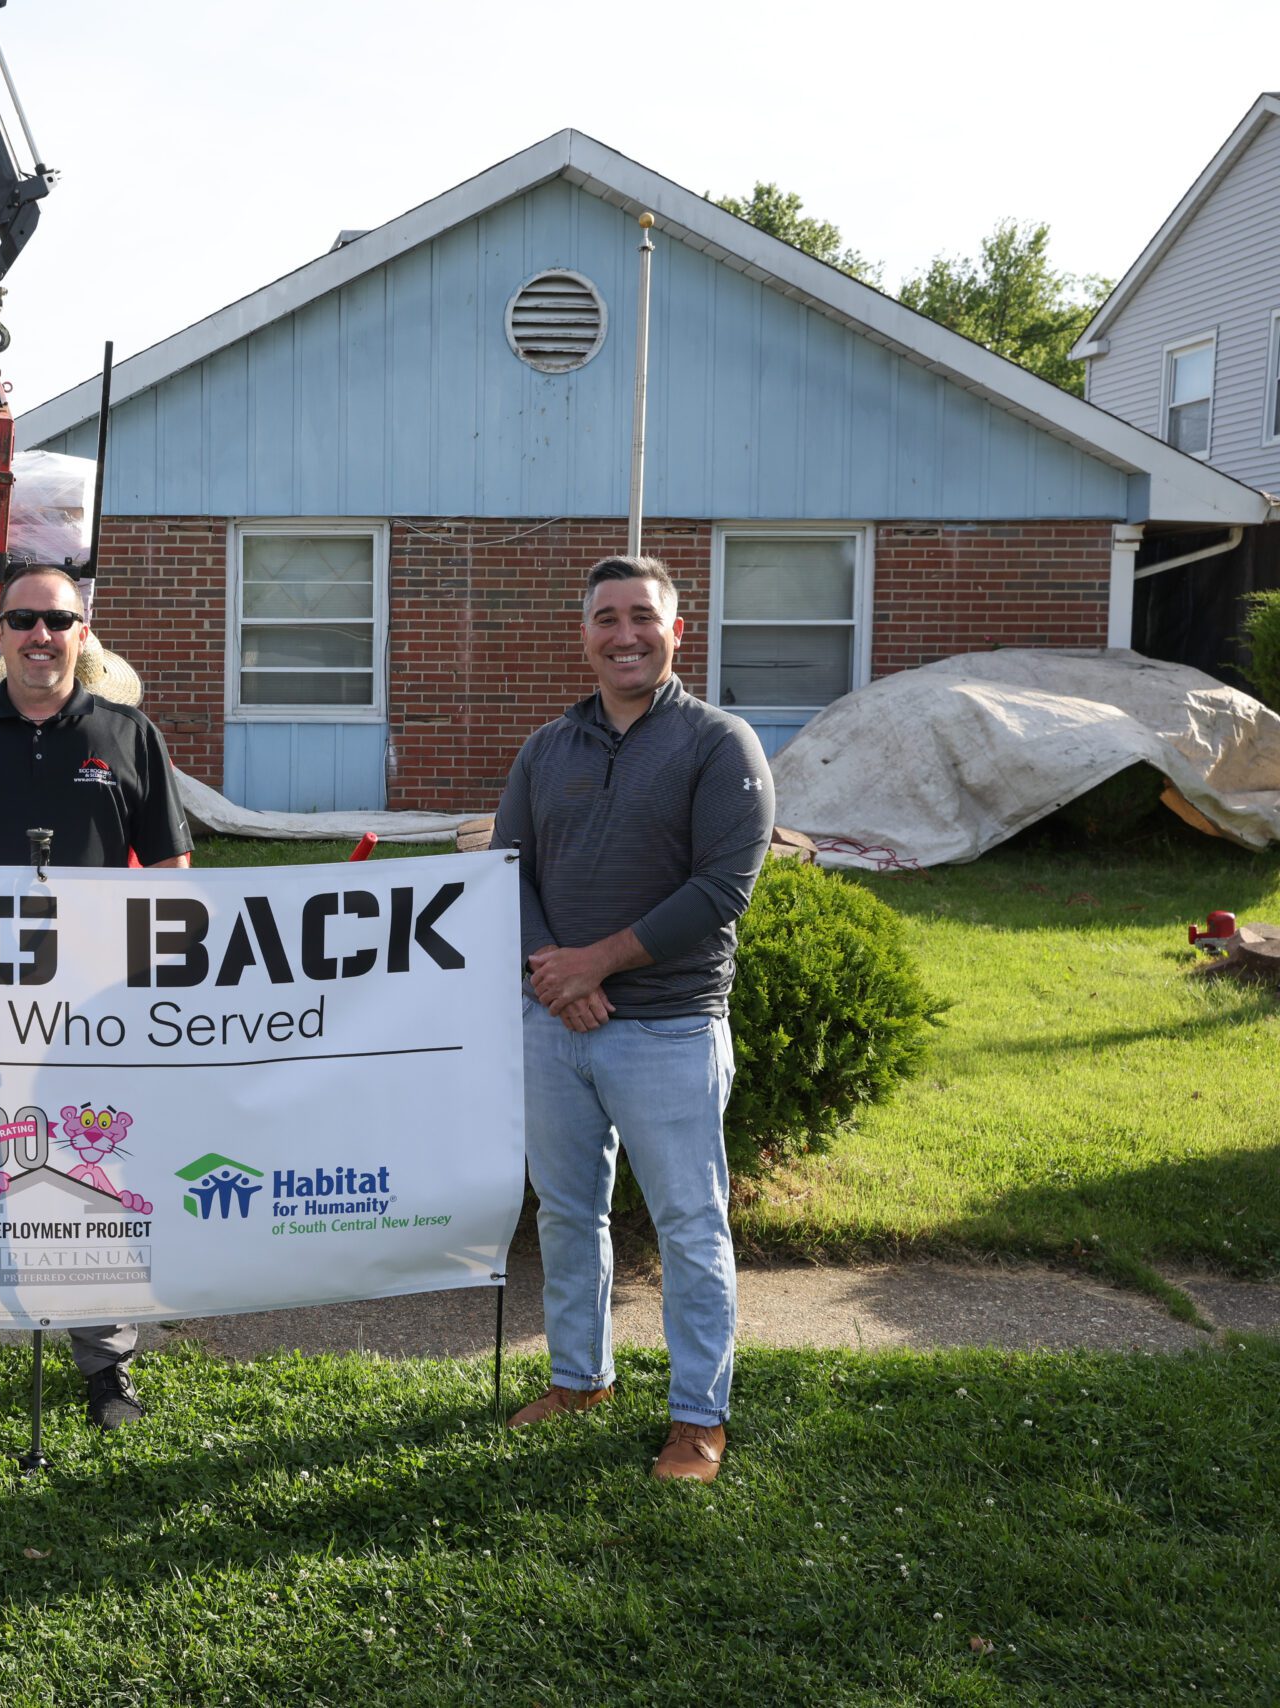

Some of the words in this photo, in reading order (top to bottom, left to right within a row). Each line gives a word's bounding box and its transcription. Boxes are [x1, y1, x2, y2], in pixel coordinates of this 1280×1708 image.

[126, 881, 466, 988] BACK
[7, 1000, 126, 1047] Who
[147, 994, 325, 1048] Served
[272, 1166, 390, 1198] Habitat
[272, 1201, 298, 1218] for
[86, 1221, 152, 1239] PROJECT
[272, 1220, 286, 1236] of
[288, 1217, 327, 1235] South
[331, 1216, 377, 1232] Central
[381, 1216, 410, 1230] New
[413, 1213, 452, 1228] Jersey
[7, 1250, 144, 1267] PLATINUM
[3, 1273, 66, 1283] PREFERRED
[68, 1271, 148, 1282] CONTRACTOR
